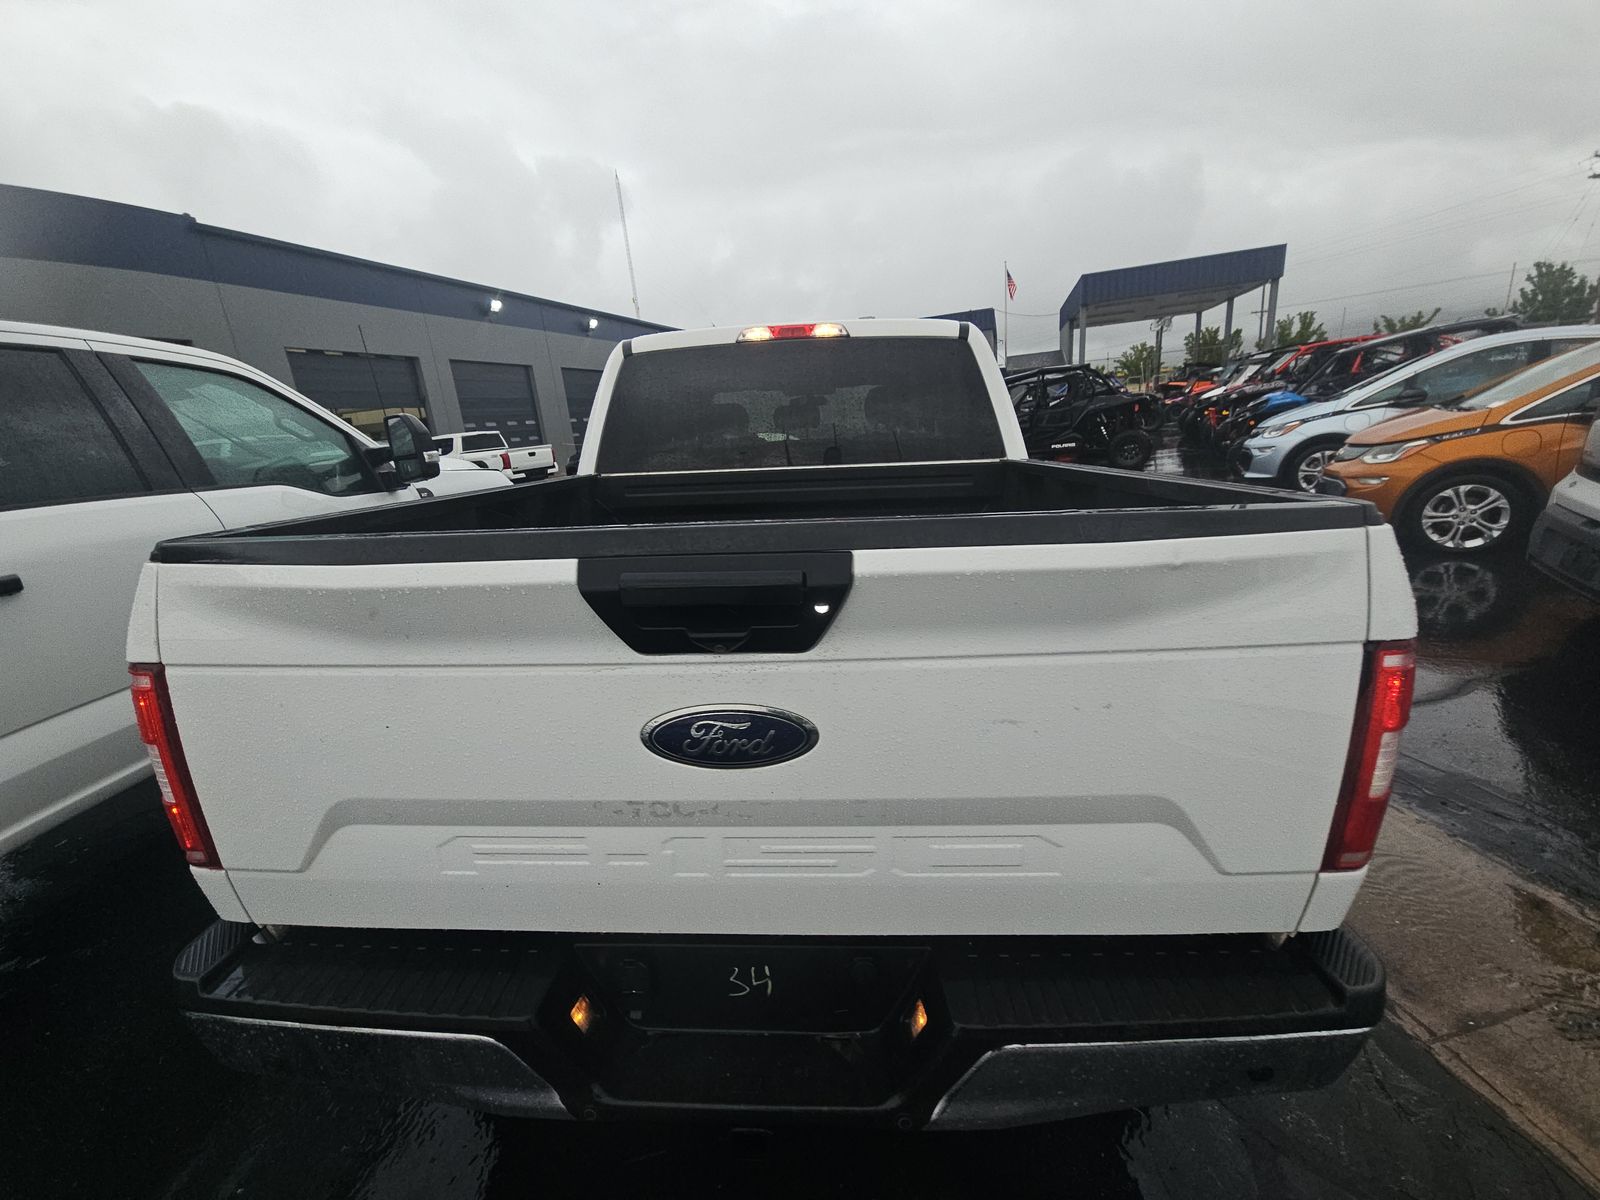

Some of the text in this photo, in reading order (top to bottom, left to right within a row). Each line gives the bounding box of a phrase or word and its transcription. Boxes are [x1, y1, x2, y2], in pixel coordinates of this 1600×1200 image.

[682, 720, 777, 755] Ford
[436, 835, 1064, 878] F-150
[728, 964, 772, 996] 34
